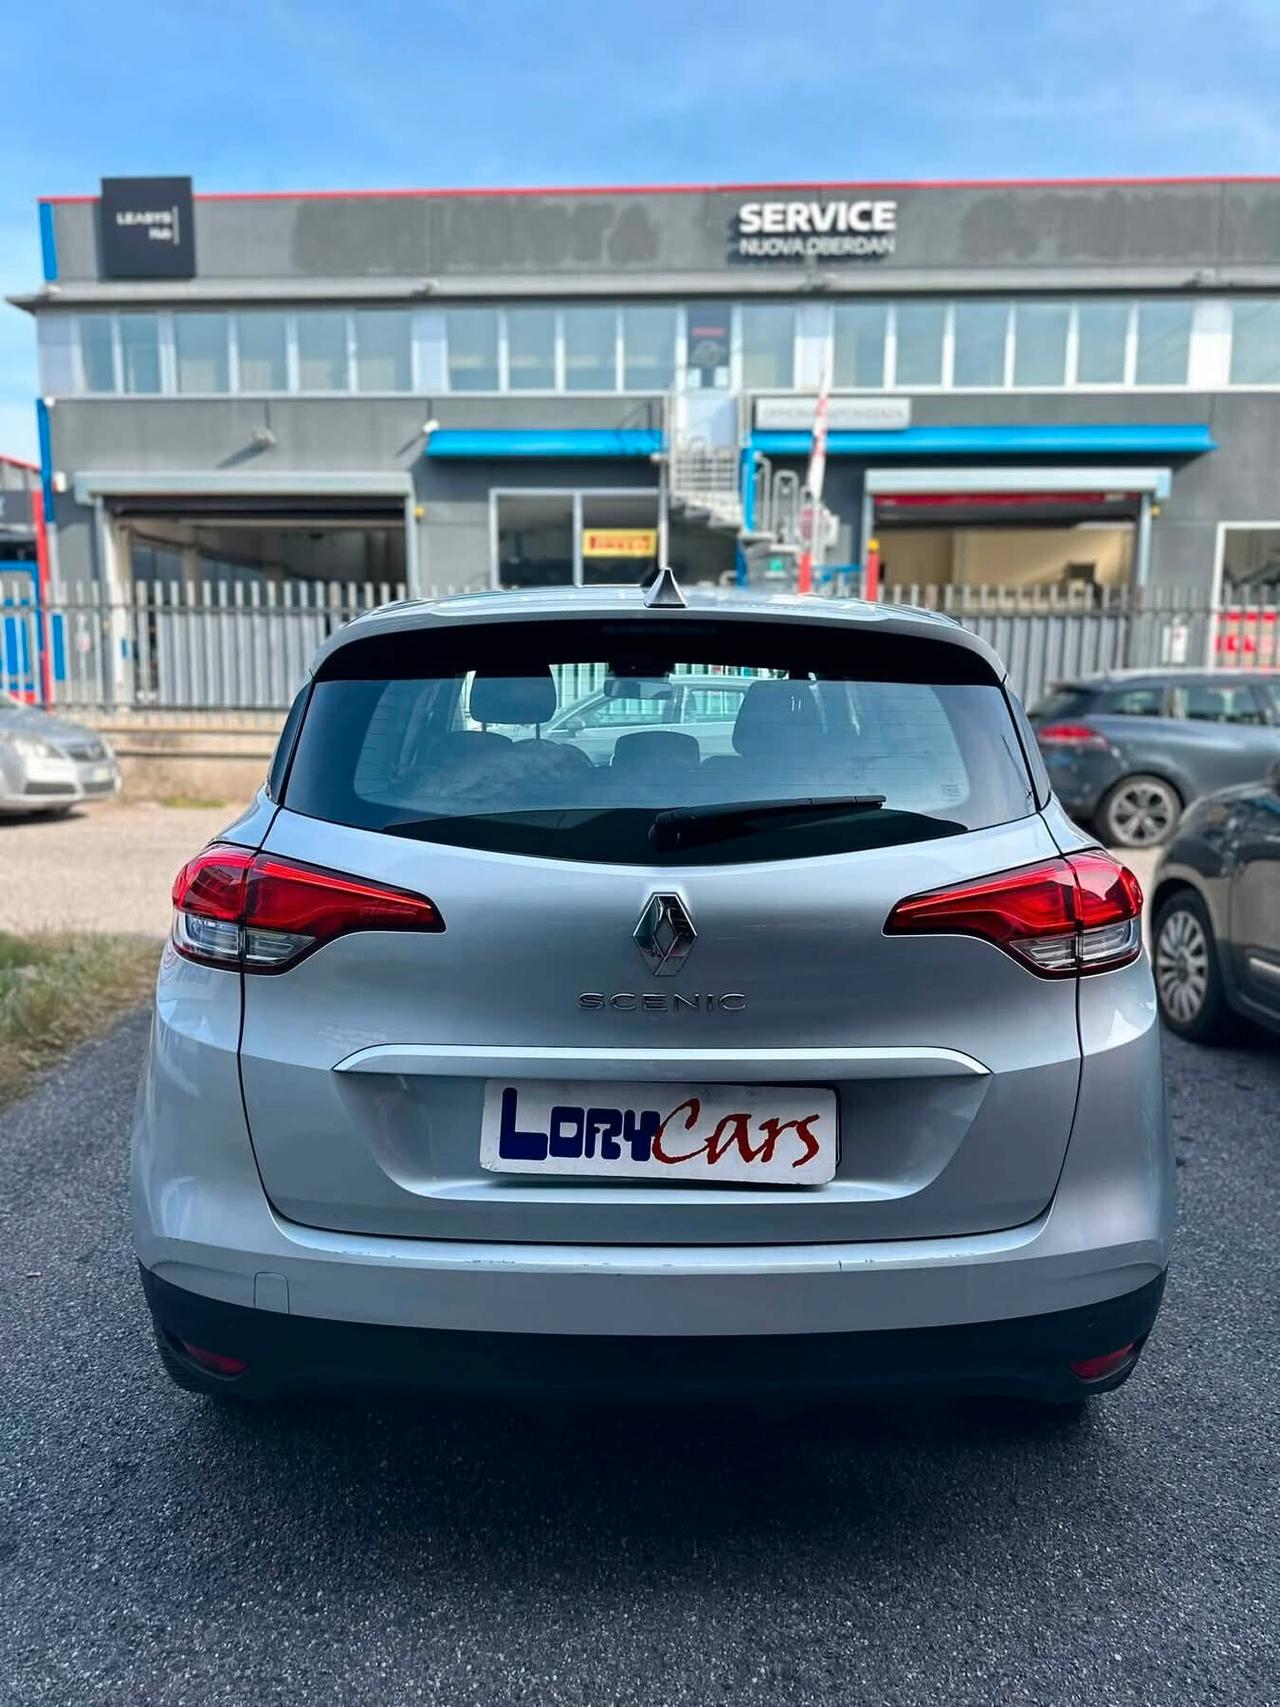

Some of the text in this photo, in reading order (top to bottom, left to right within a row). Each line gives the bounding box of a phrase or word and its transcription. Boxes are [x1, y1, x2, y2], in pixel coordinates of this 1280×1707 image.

[738, 200, 897, 233] SERVICE
[739, 237, 805, 256] NUOVA
[575, 992, 747, 1012] SCENIC
